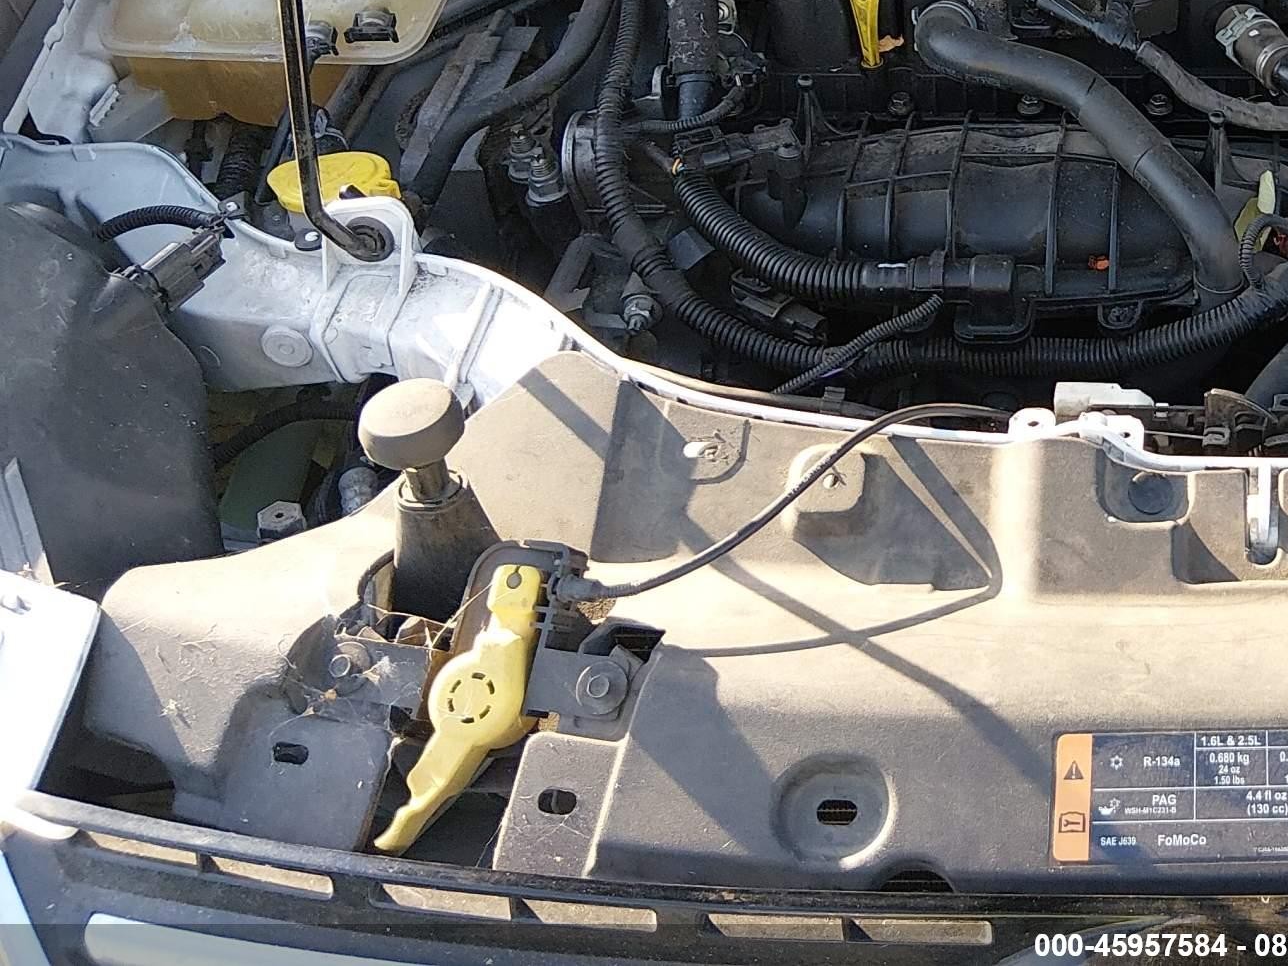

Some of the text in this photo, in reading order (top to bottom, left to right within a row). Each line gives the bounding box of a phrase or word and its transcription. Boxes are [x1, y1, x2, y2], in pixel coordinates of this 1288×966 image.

[1201, 735, 1261, 746] 1.6L & 2.5L
[1143, 755, 1181, 768] R-134a
[1209, 752, 1250, 766] 0.680 kg
[1218, 764, 1241, 774] 24 oz
[1213, 774, 1245, 785] 1.50 lbs
[1152, 794, 1177, 806] PAG
[1245, 789, 1288, 801] 4.4 fl oz
[1247, 803, 1288, 816] (130 cc)
[1100, 836, 1137, 846] SAE J639
[1157, 833, 1208, 846] FoMoCo
